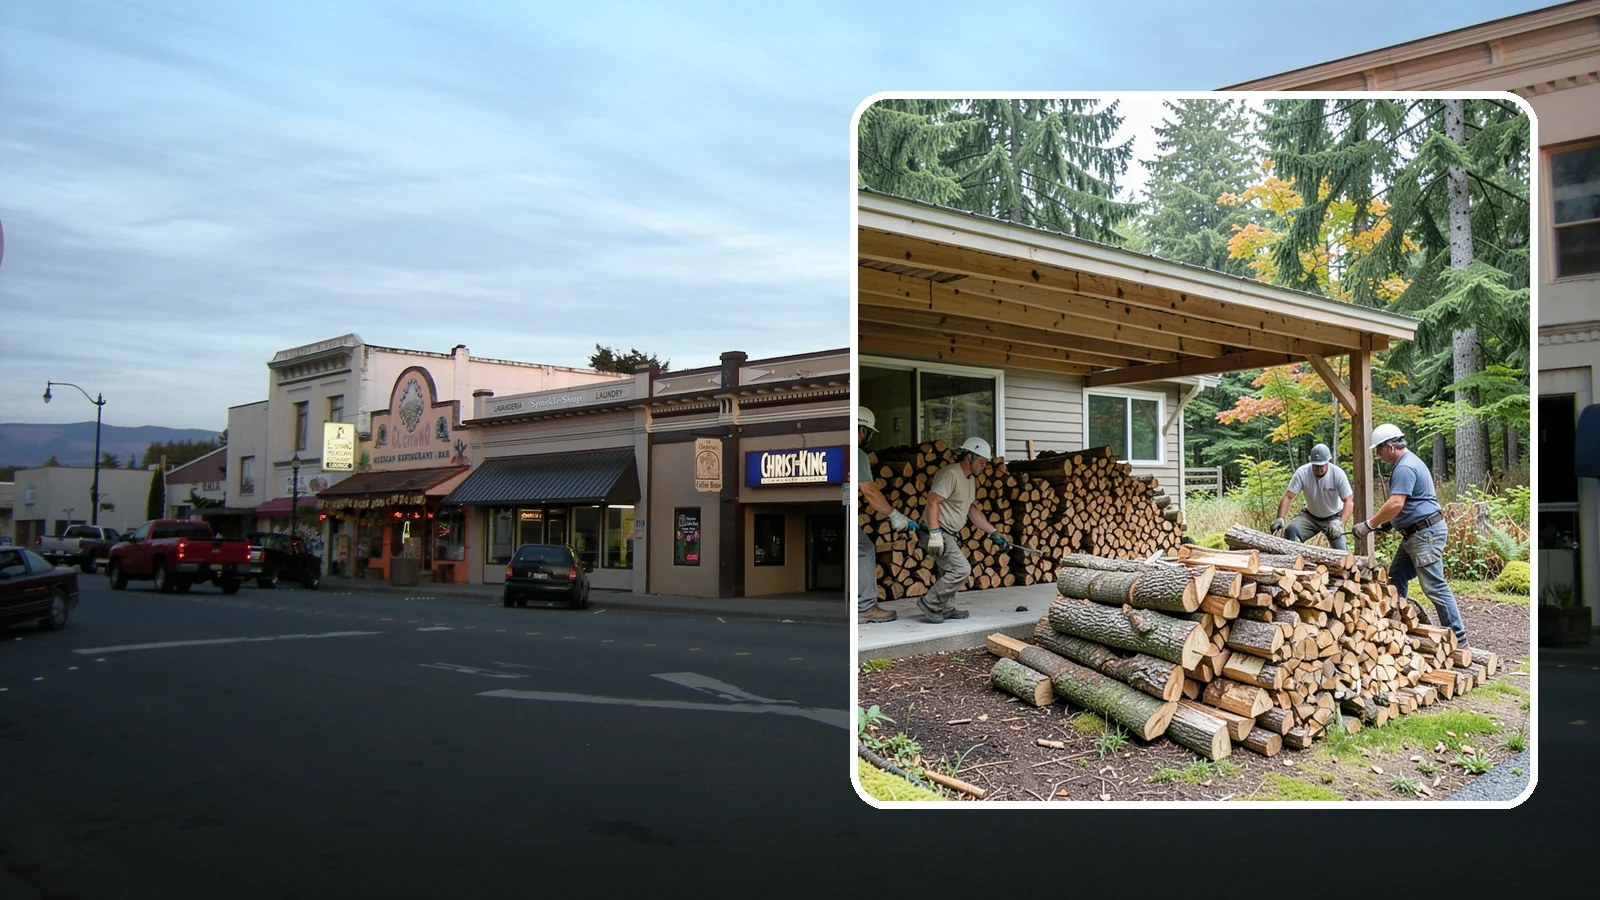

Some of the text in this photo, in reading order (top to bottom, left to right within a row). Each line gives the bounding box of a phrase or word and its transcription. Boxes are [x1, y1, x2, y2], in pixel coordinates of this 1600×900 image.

[493, 402, 523, 413] LAVANDERIA
[561, 394, 583, 405] Shop
[595, 388, 624, 400] LAUNDRY
[373, 449, 450, 464] MEXICAN RESTAURANT BAR
[760, 450, 828, 478] CHRIST KING
[696, 480, 722, 489] Coffee House
